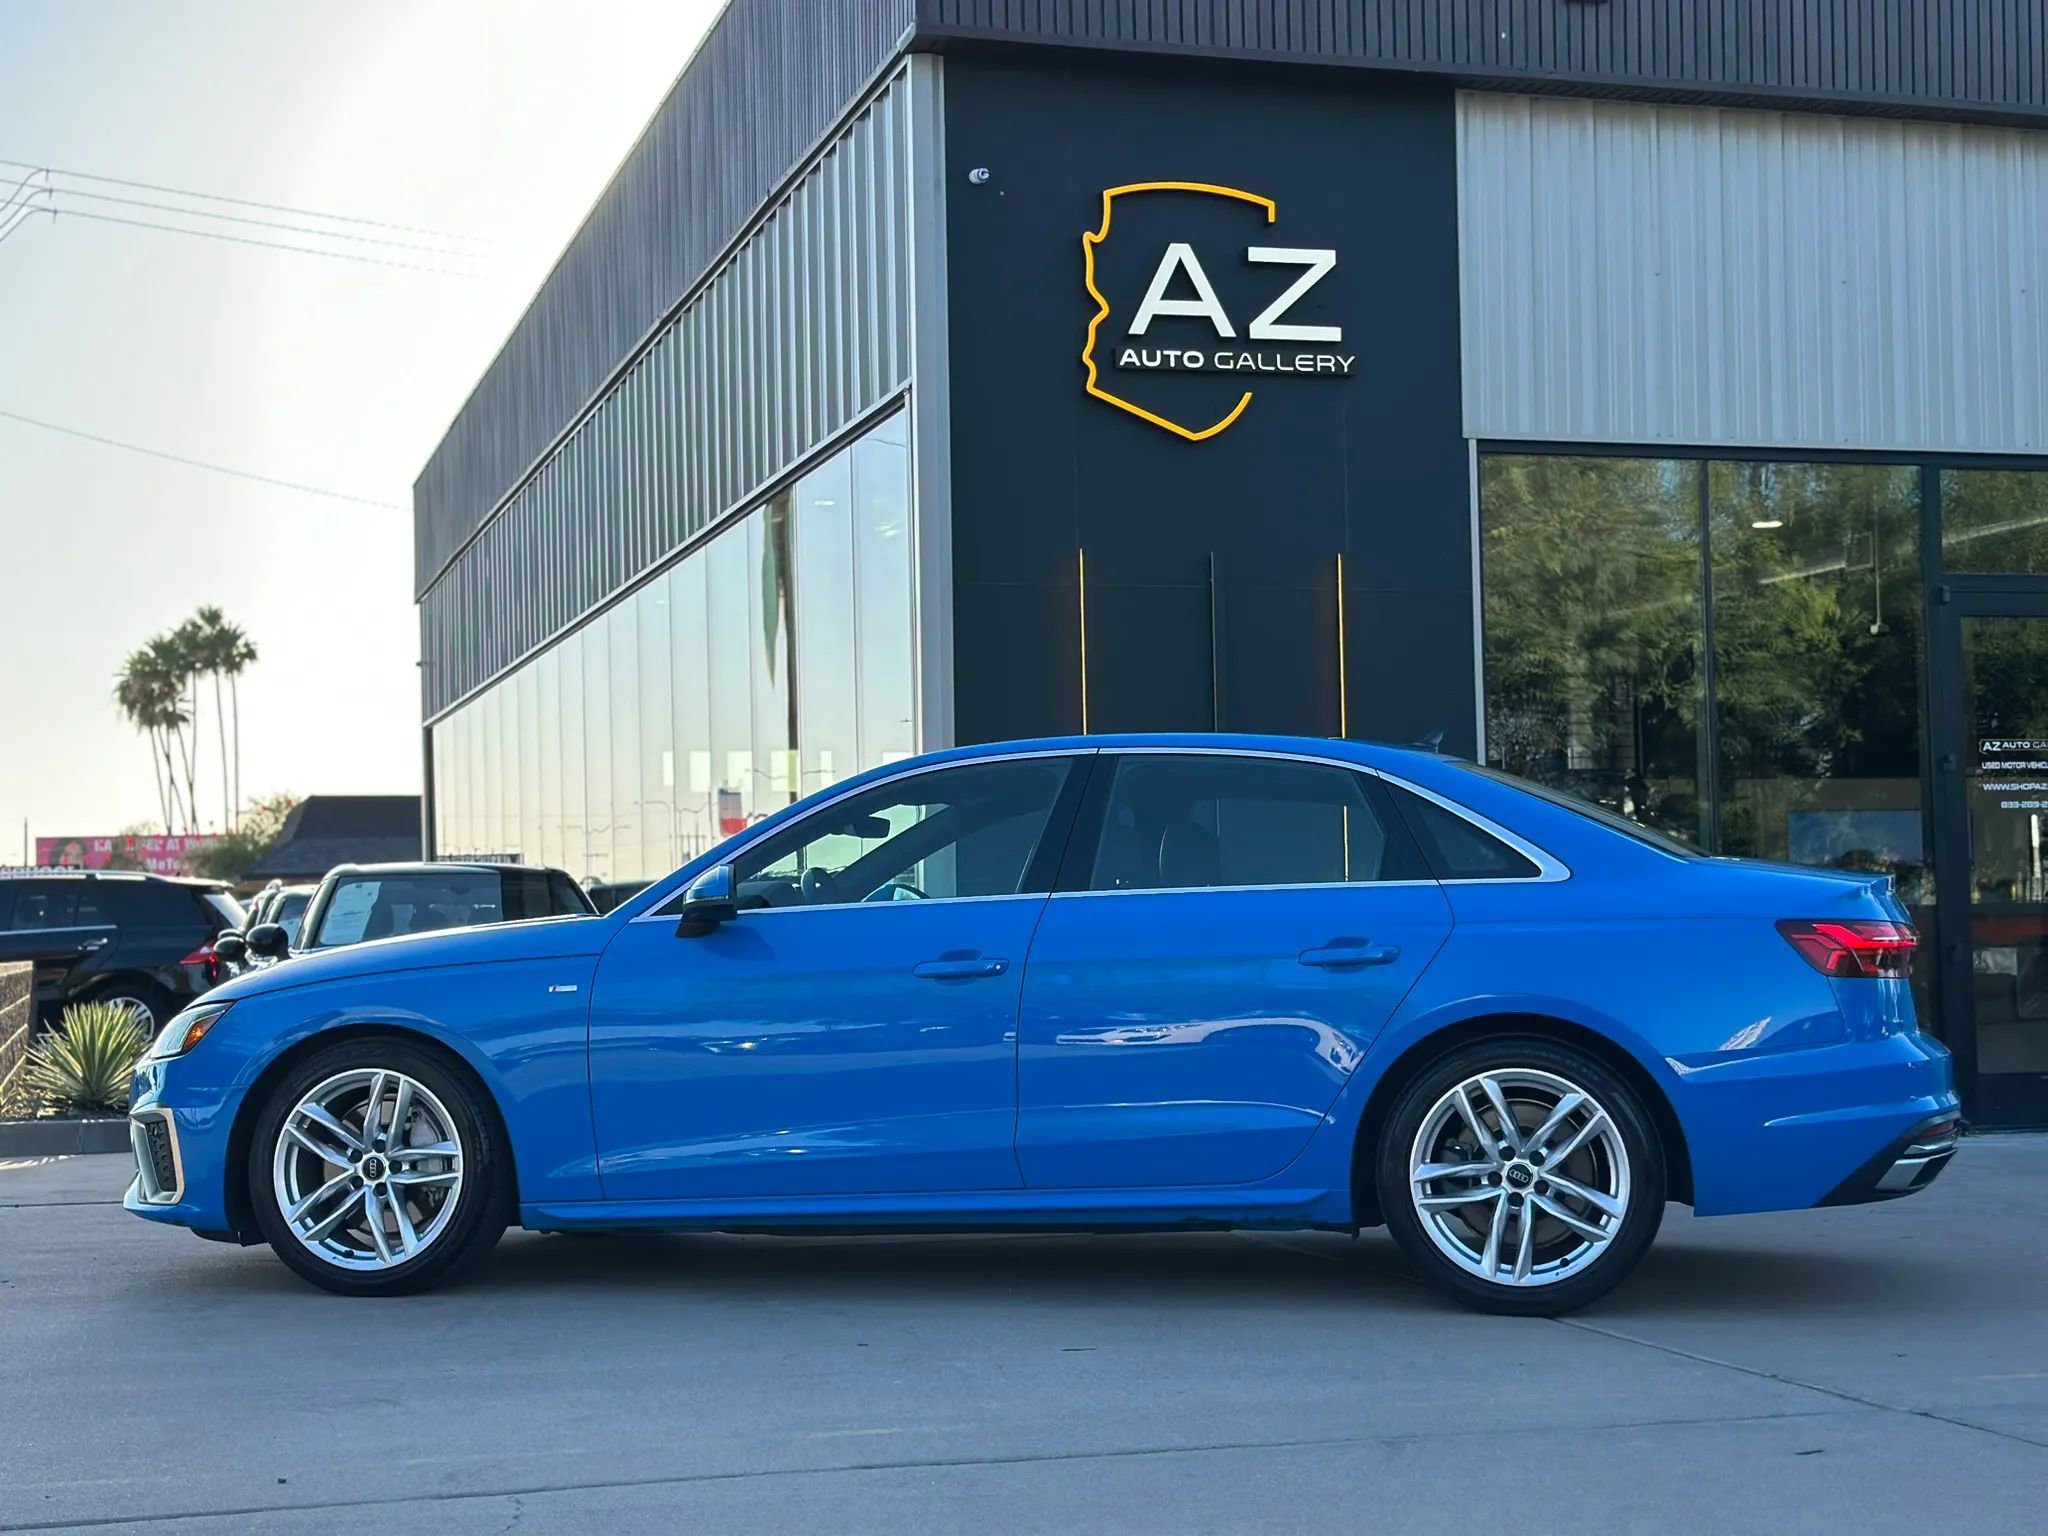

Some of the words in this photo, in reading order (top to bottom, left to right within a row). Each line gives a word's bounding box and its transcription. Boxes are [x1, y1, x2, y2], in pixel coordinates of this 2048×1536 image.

[1128, 242, 1342, 342] AZ
[1119, 348, 1205, 369] AUTO
[1213, 351, 1356, 373] GALLERY
[1982, 741, 2002, 751] AZ
[2002, 741, 2031, 749] AUTO
[2032, 741, 2048, 749] GA
[1981, 761, 2001, 770] USED
[2001, 761, 2026, 770] MOTOR
